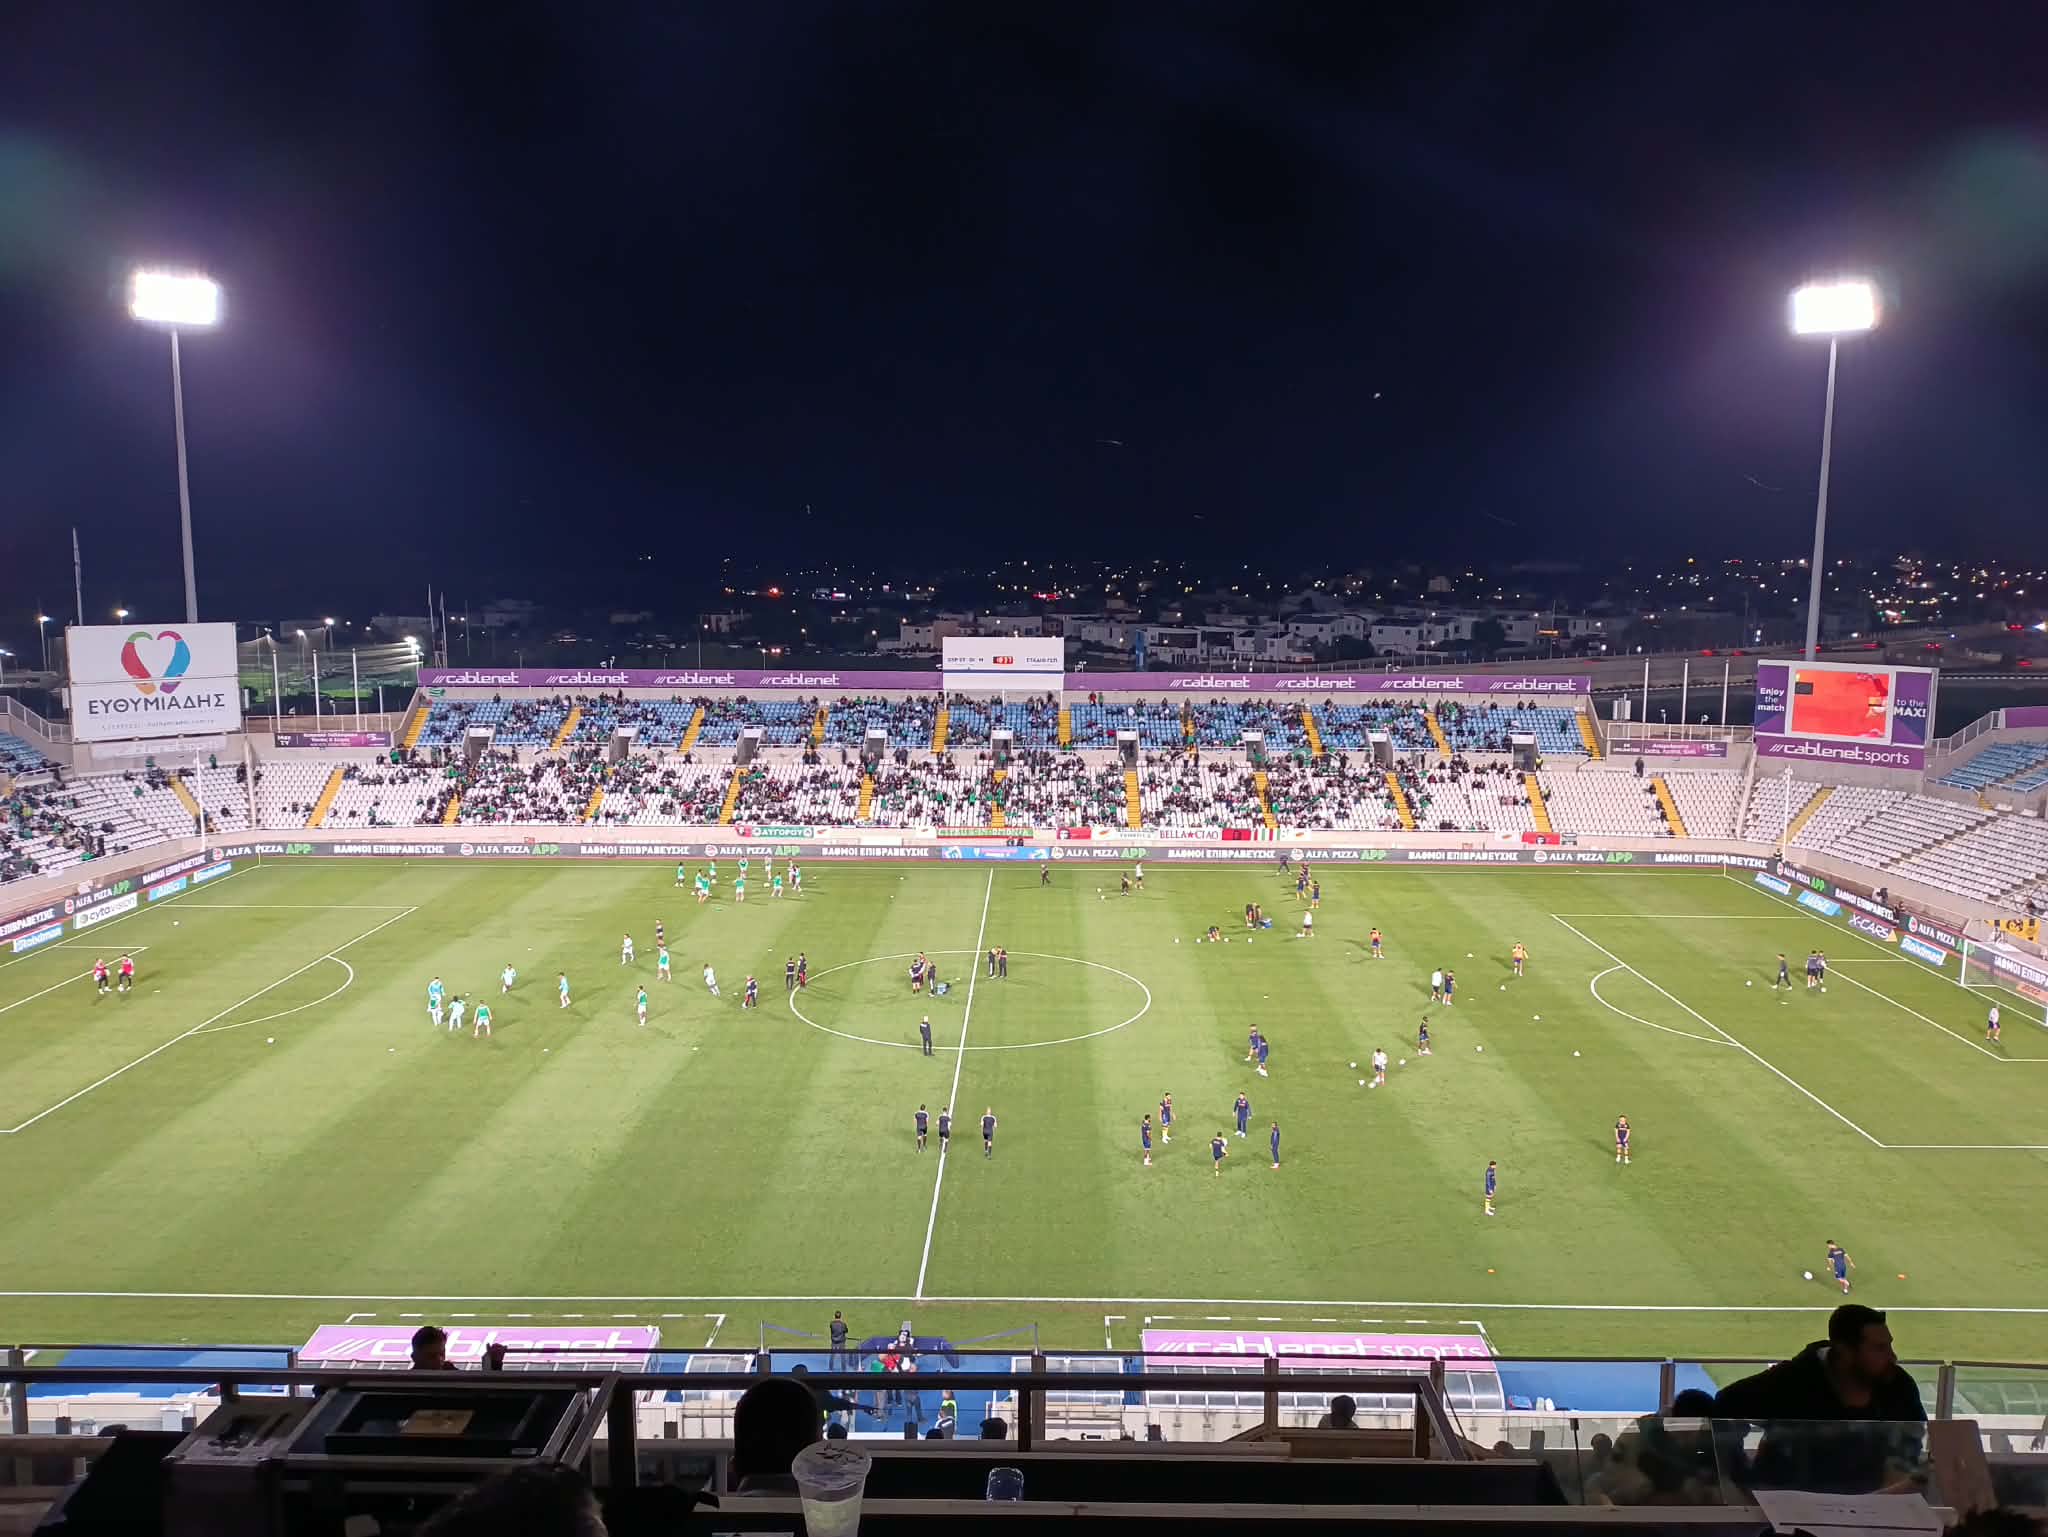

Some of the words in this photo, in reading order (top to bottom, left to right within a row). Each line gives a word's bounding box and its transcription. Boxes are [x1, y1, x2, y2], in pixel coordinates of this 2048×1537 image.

[446, 672, 519, 684] cablenet
[559, 672, 628, 684] cablenet
[666, 672, 735, 684] cablenet
[772, 673, 840, 685] cablenet
[1182, 676, 1250, 688] cablenet
[1287, 676, 1356, 689] cablenet
[1394, 676, 1464, 689] cablenet
[1504, 678, 1576, 690] cablenet
[1760, 687, 1785, 696] Enjoy
[88, 694, 224, 715] ΕΥΘΥΜΙΑΔΗΣ
[1764, 695, 1778, 703] the
[1896, 698, 1907, 706] to
[1909, 698, 1924, 707] the
[1758, 704, 1785, 712] match
[1893, 706, 1926, 718] MAX!
[1160, 830, 1188, 839] BELLA
[226, 847, 251, 856] ALFA
[256, 845, 284, 854] PIZZA
[286, 844, 313, 854] APP
[476, 846, 500, 854] ALFA
[503, 846, 530, 854] PIZZA
[532, 844, 560, 855] APP
[720, 847, 743, 855] ALFA
[746, 847, 773, 855] PIZZA
[774, 846, 800, 856] APP
[1066, 849, 1089, 857] ALFA
[1093, 849, 1118, 857] PIZZA
[1120, 848, 1146, 858] APP
[1306, 850, 1329, 859] ALFA
[1332, 851, 1359, 859] PIZZA
[1360, 850, 1387, 860] APP
[1550, 853, 1572, 862] ALFA
[1577, 853, 1604, 862] PIZZA
[1606, 852, 1633, 863] APP
[1849, 912, 1889, 939] X-CARS
[1918, 924, 1935, 938] ALFA
[1936, 932, 1956, 947] PIZZA
[370, 1330, 636, 1359] cblenet
